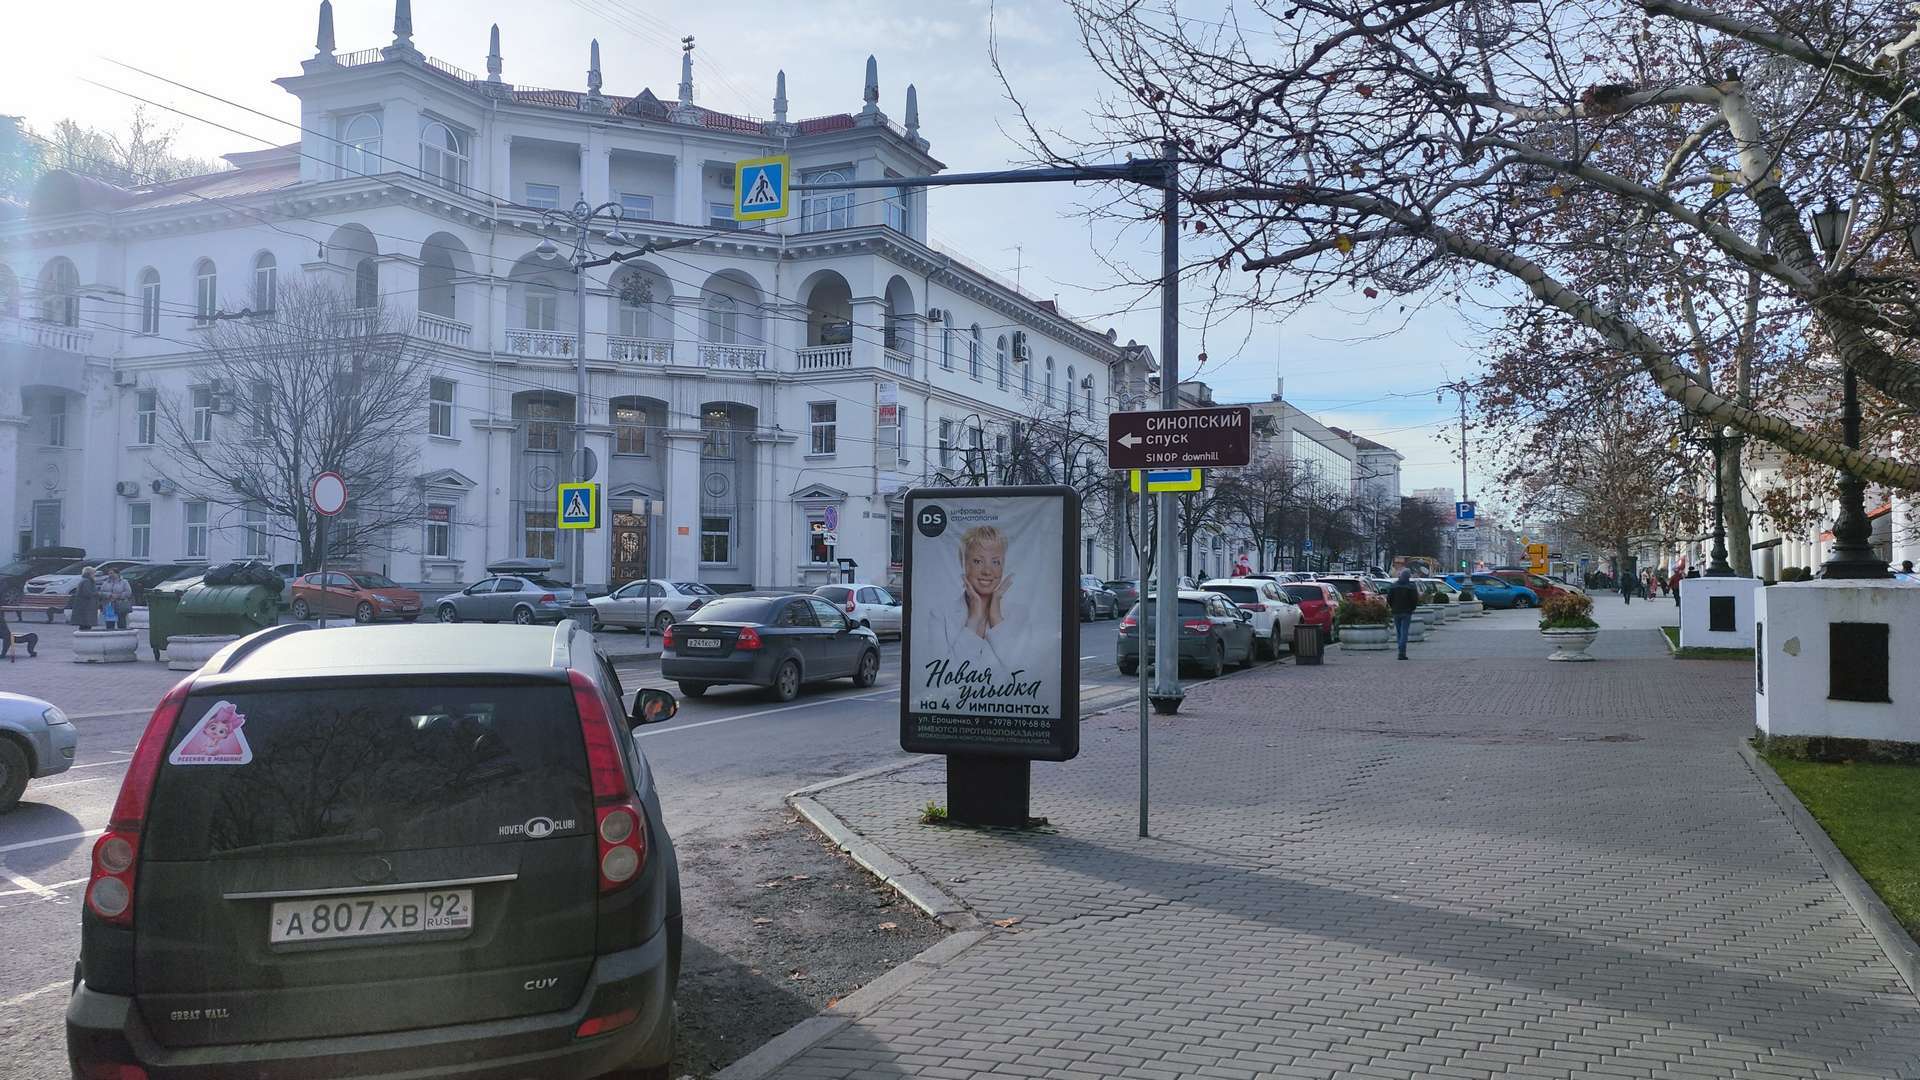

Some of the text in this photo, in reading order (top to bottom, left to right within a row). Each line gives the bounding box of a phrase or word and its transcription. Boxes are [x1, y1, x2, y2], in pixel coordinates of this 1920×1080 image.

[1146, 410, 1241, 431] СИНОПСКИЙ
[1146, 434, 1189, 447] спуск
[1146, 451, 1219, 462] SINOP downhill
[922, 513, 942, 525] DS
[925, 659, 992, 688] Новая
[956, 669, 1042, 710] улыбка
[920, 699, 1049, 715] на 4 имплантах
[988, 718, 1012, 727] +7978
[918, 725, 1050, 738] ИМЕЮТСЯ ПРОТИВОПОКАЗАНИЯ
[499, 819, 576, 836] HOVER CLUB!
[430, 893, 461, 917] 92
[427, 917, 450, 928] RUS
[524, 977, 558, 991] CUV
[170, 1008, 232, 1021] GREAT WALL
